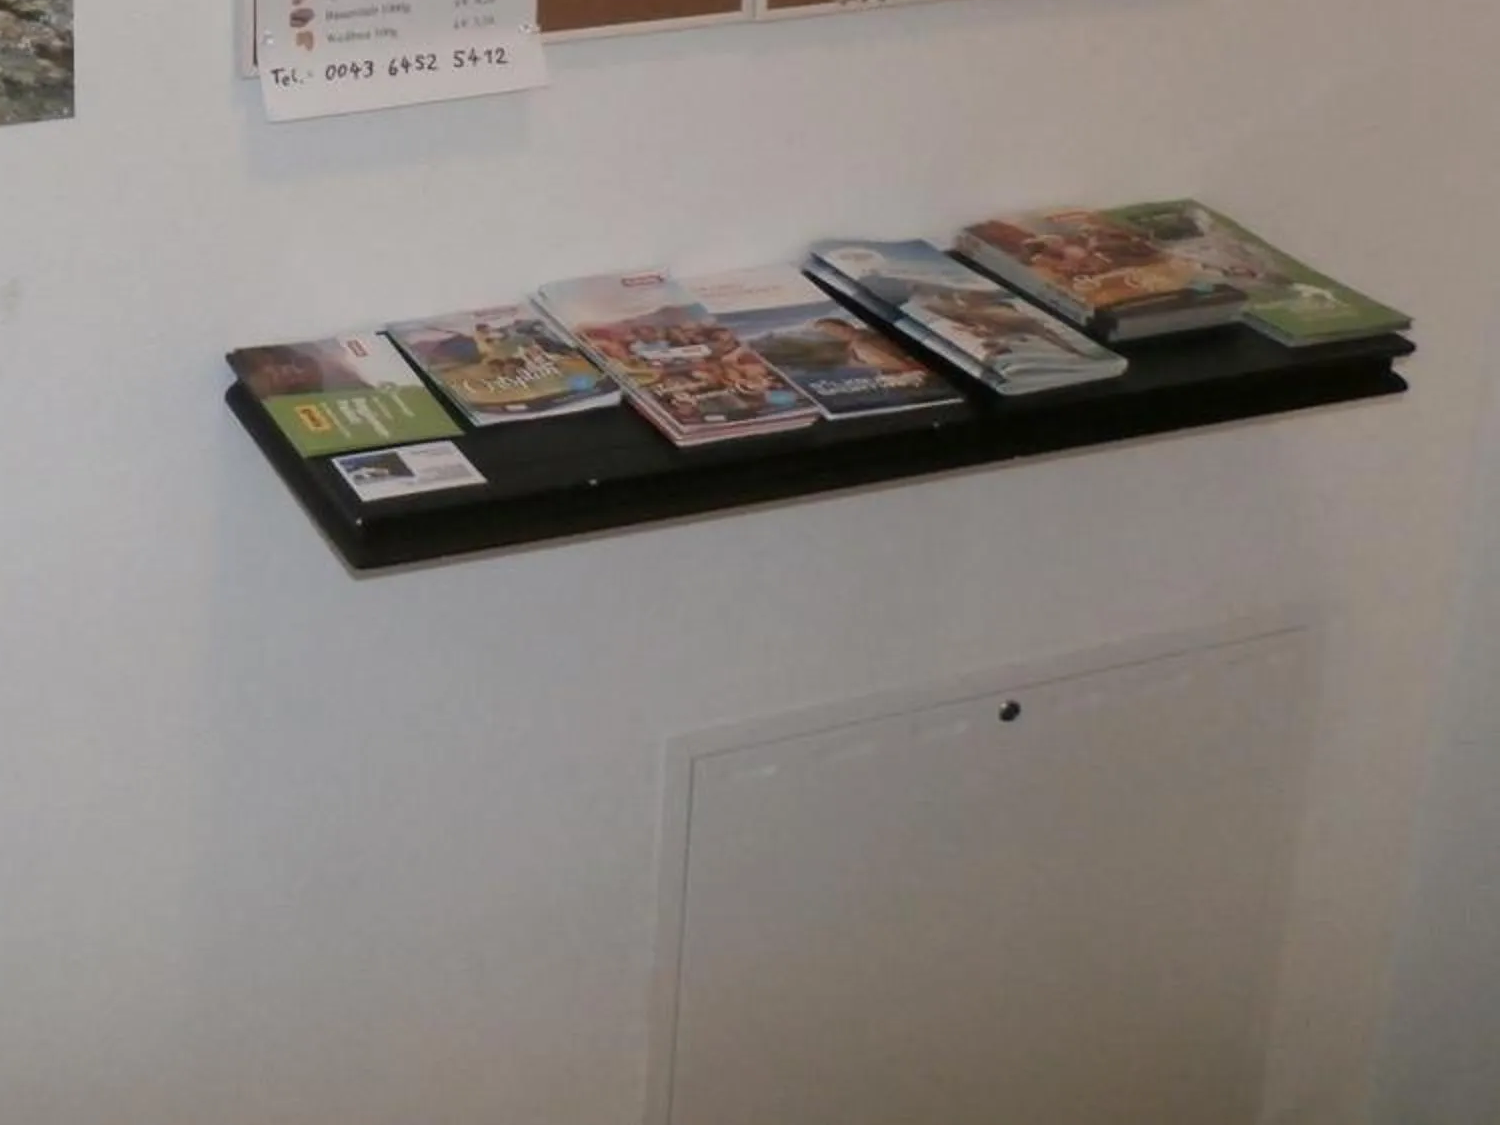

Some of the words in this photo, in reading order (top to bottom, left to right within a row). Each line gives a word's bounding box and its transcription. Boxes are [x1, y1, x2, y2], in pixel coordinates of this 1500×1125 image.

[324, 60, 375, 81] 0043
[387, 53, 438, 77] 6452
[452, 47, 509, 69] 5412
